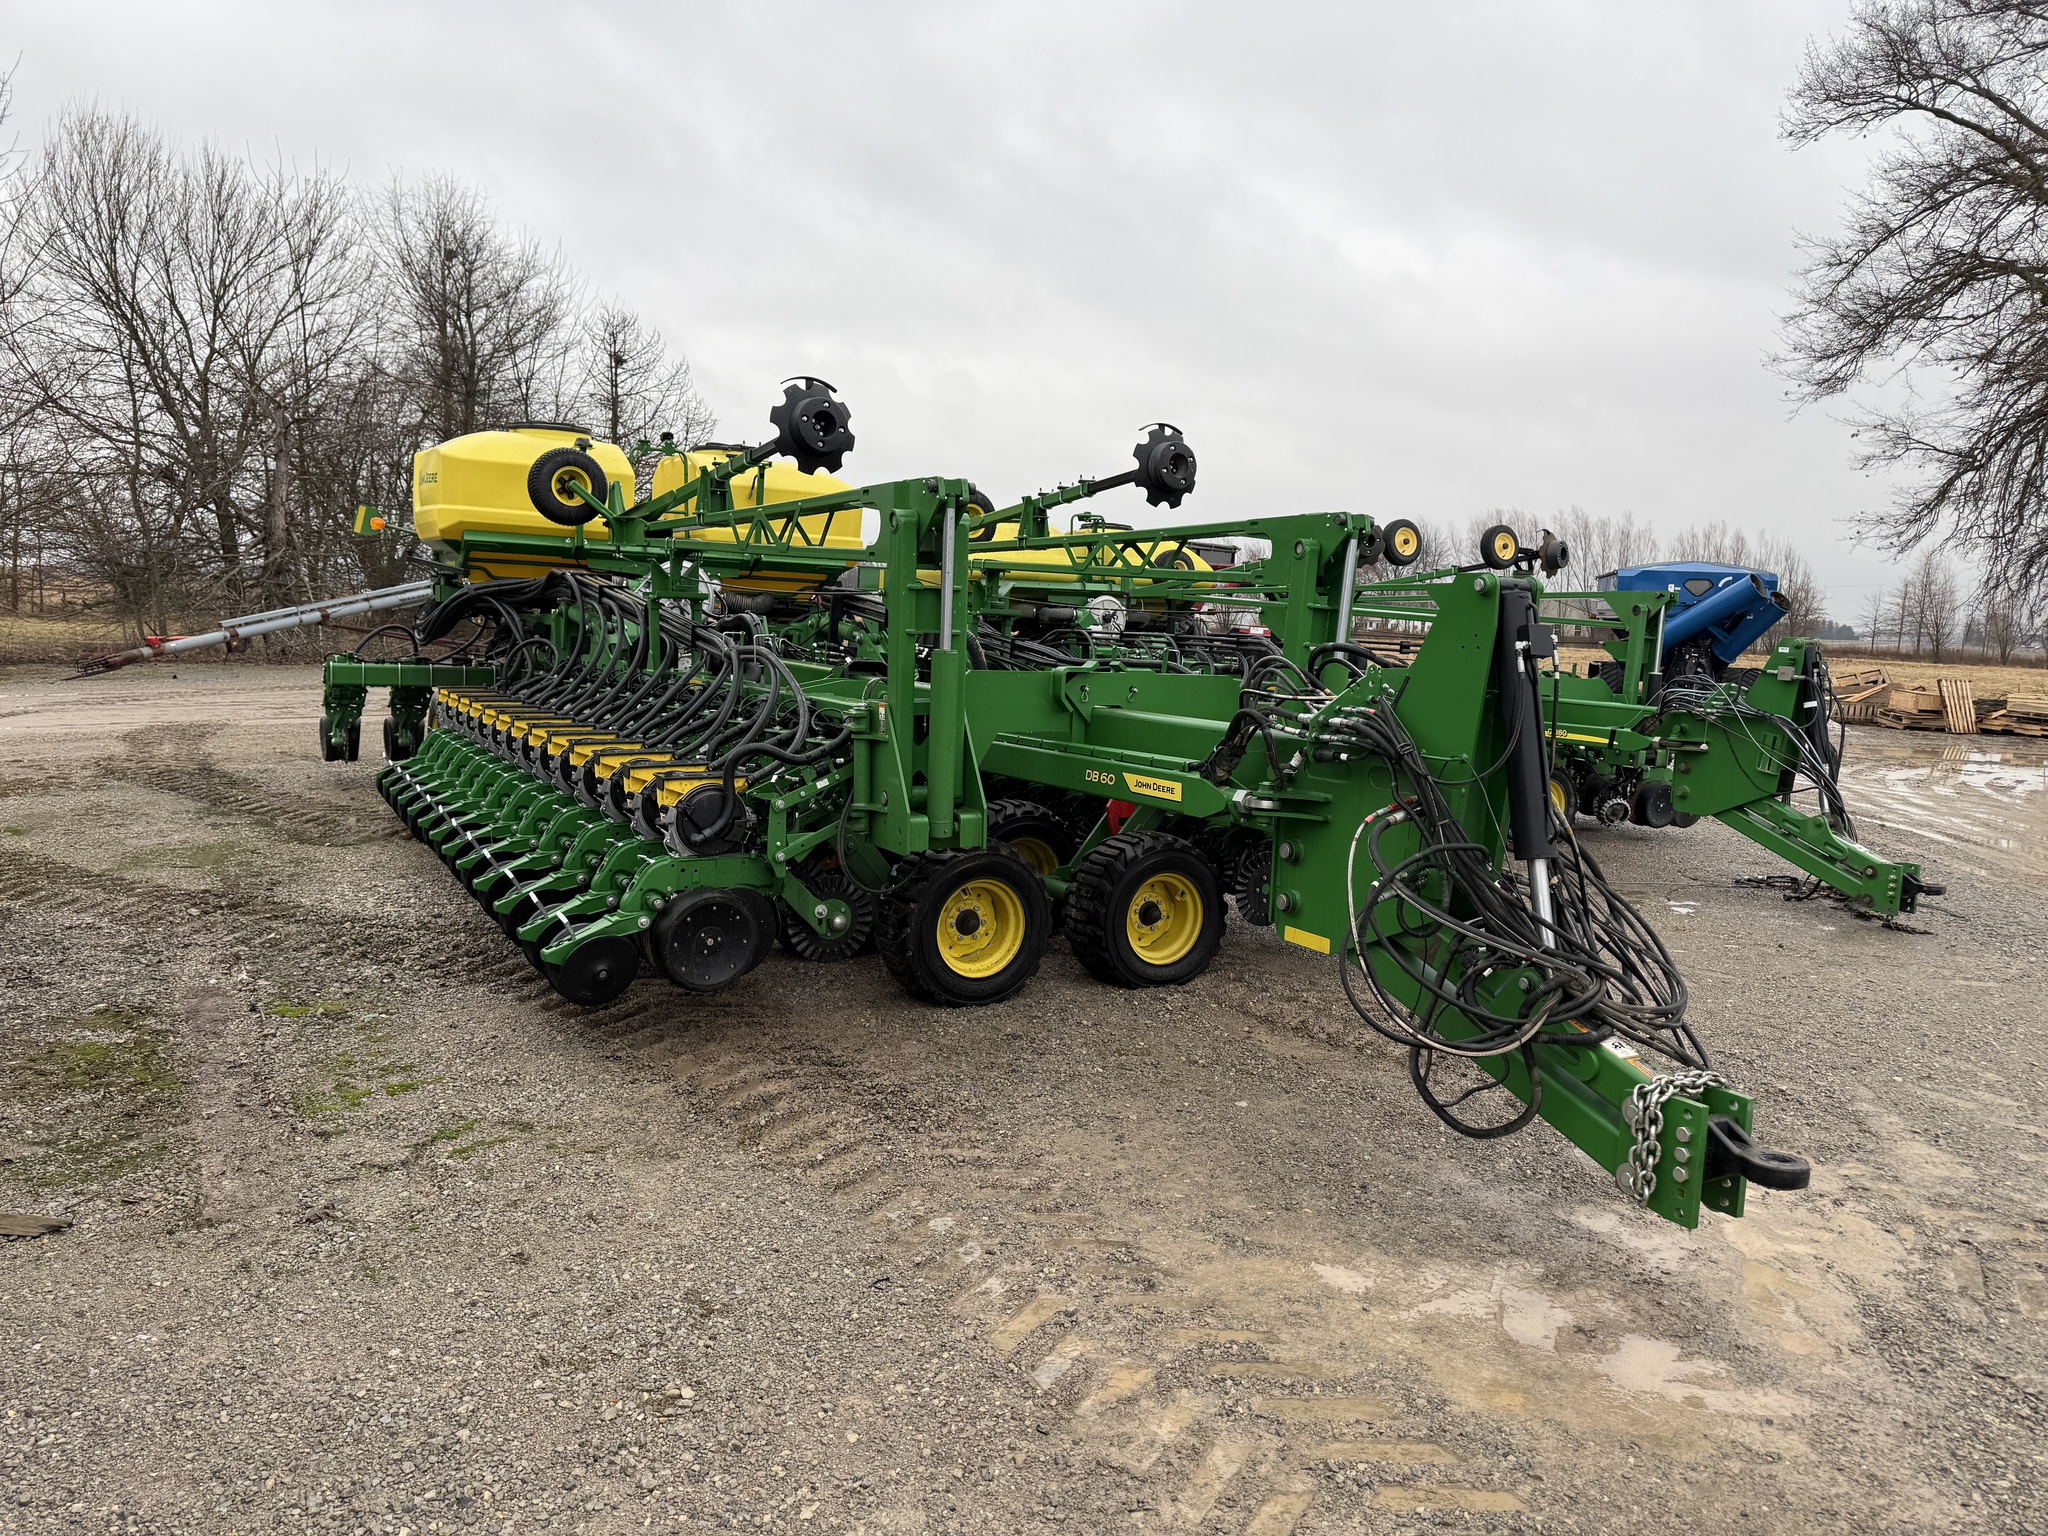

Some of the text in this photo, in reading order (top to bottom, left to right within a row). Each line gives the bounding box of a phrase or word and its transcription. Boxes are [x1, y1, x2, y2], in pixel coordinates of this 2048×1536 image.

[1085, 769, 1116, 785] DB 60
[1134, 779, 1175, 795] JOHN DEERE
